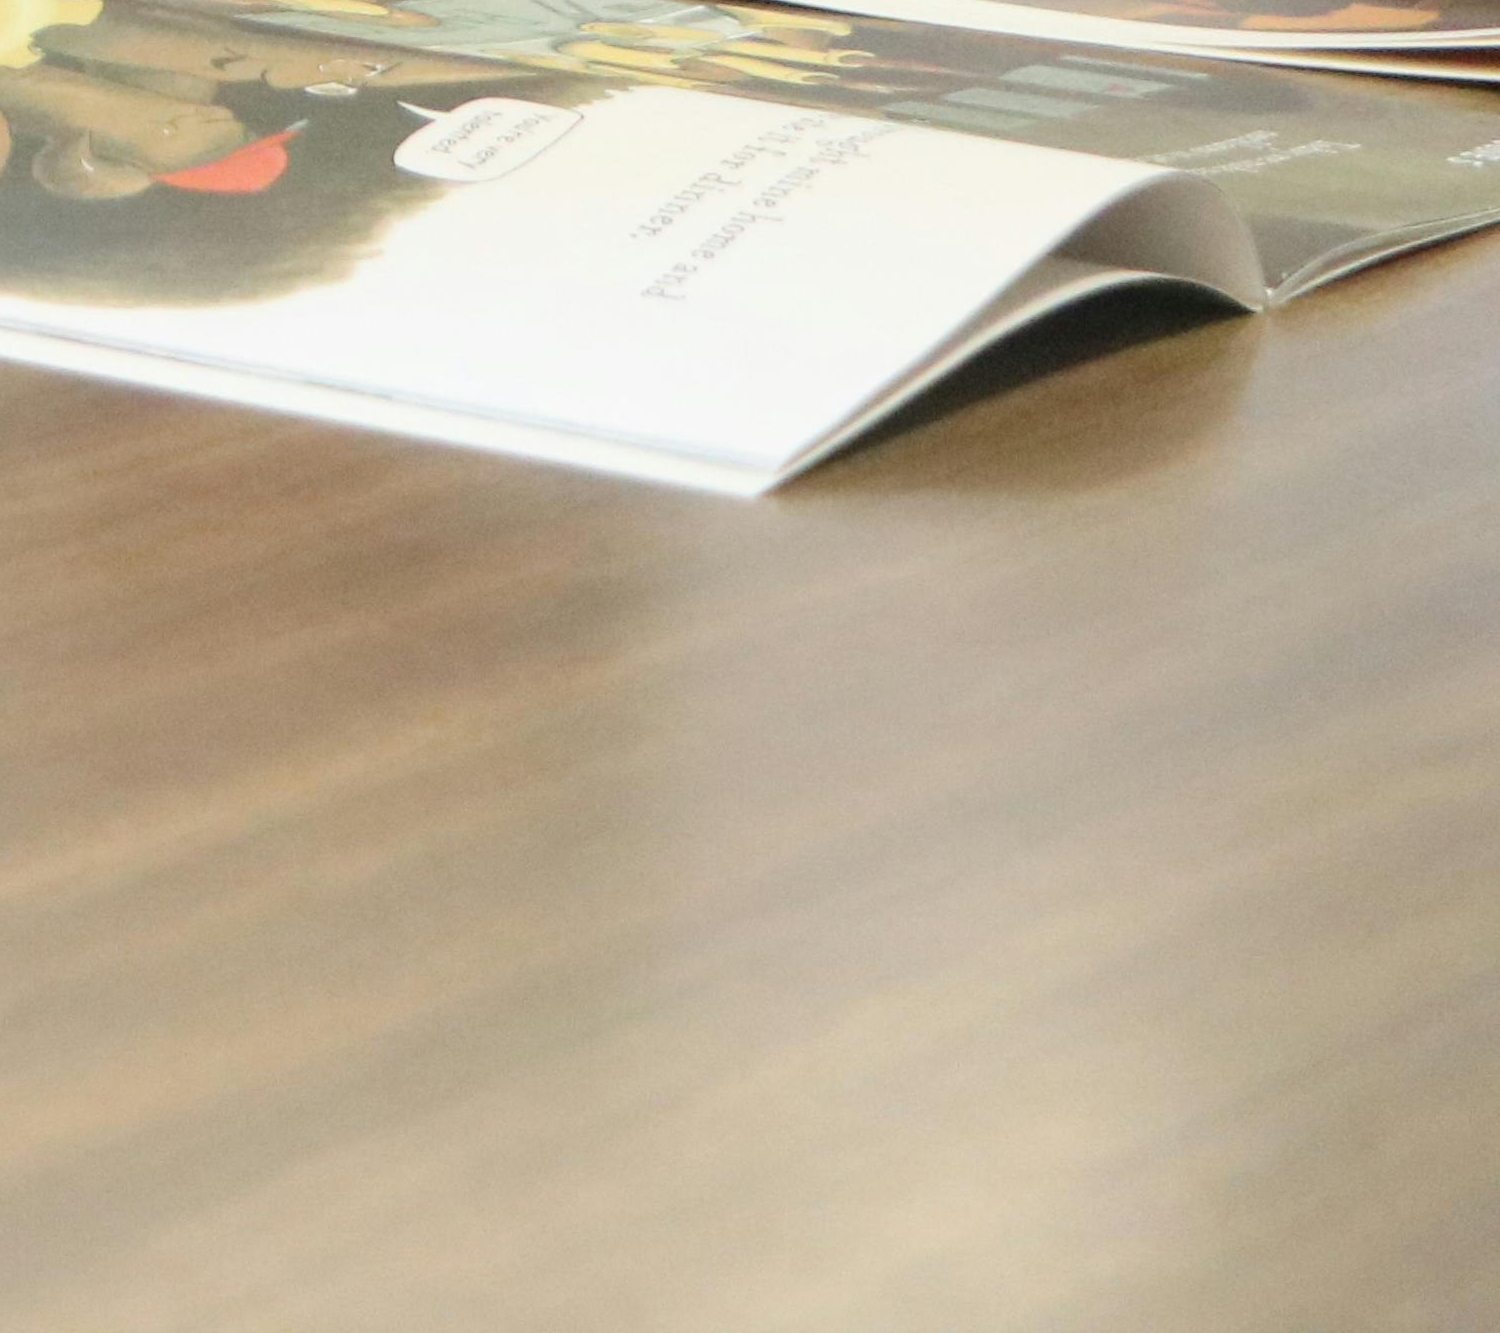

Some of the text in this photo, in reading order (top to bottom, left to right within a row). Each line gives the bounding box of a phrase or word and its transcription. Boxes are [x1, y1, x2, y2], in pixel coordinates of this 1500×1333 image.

[720, 143, 787, 169] for
[752, 166, 820, 208] mine
[690, 210, 785, 260] home
[640, 261, 698, 300] and
